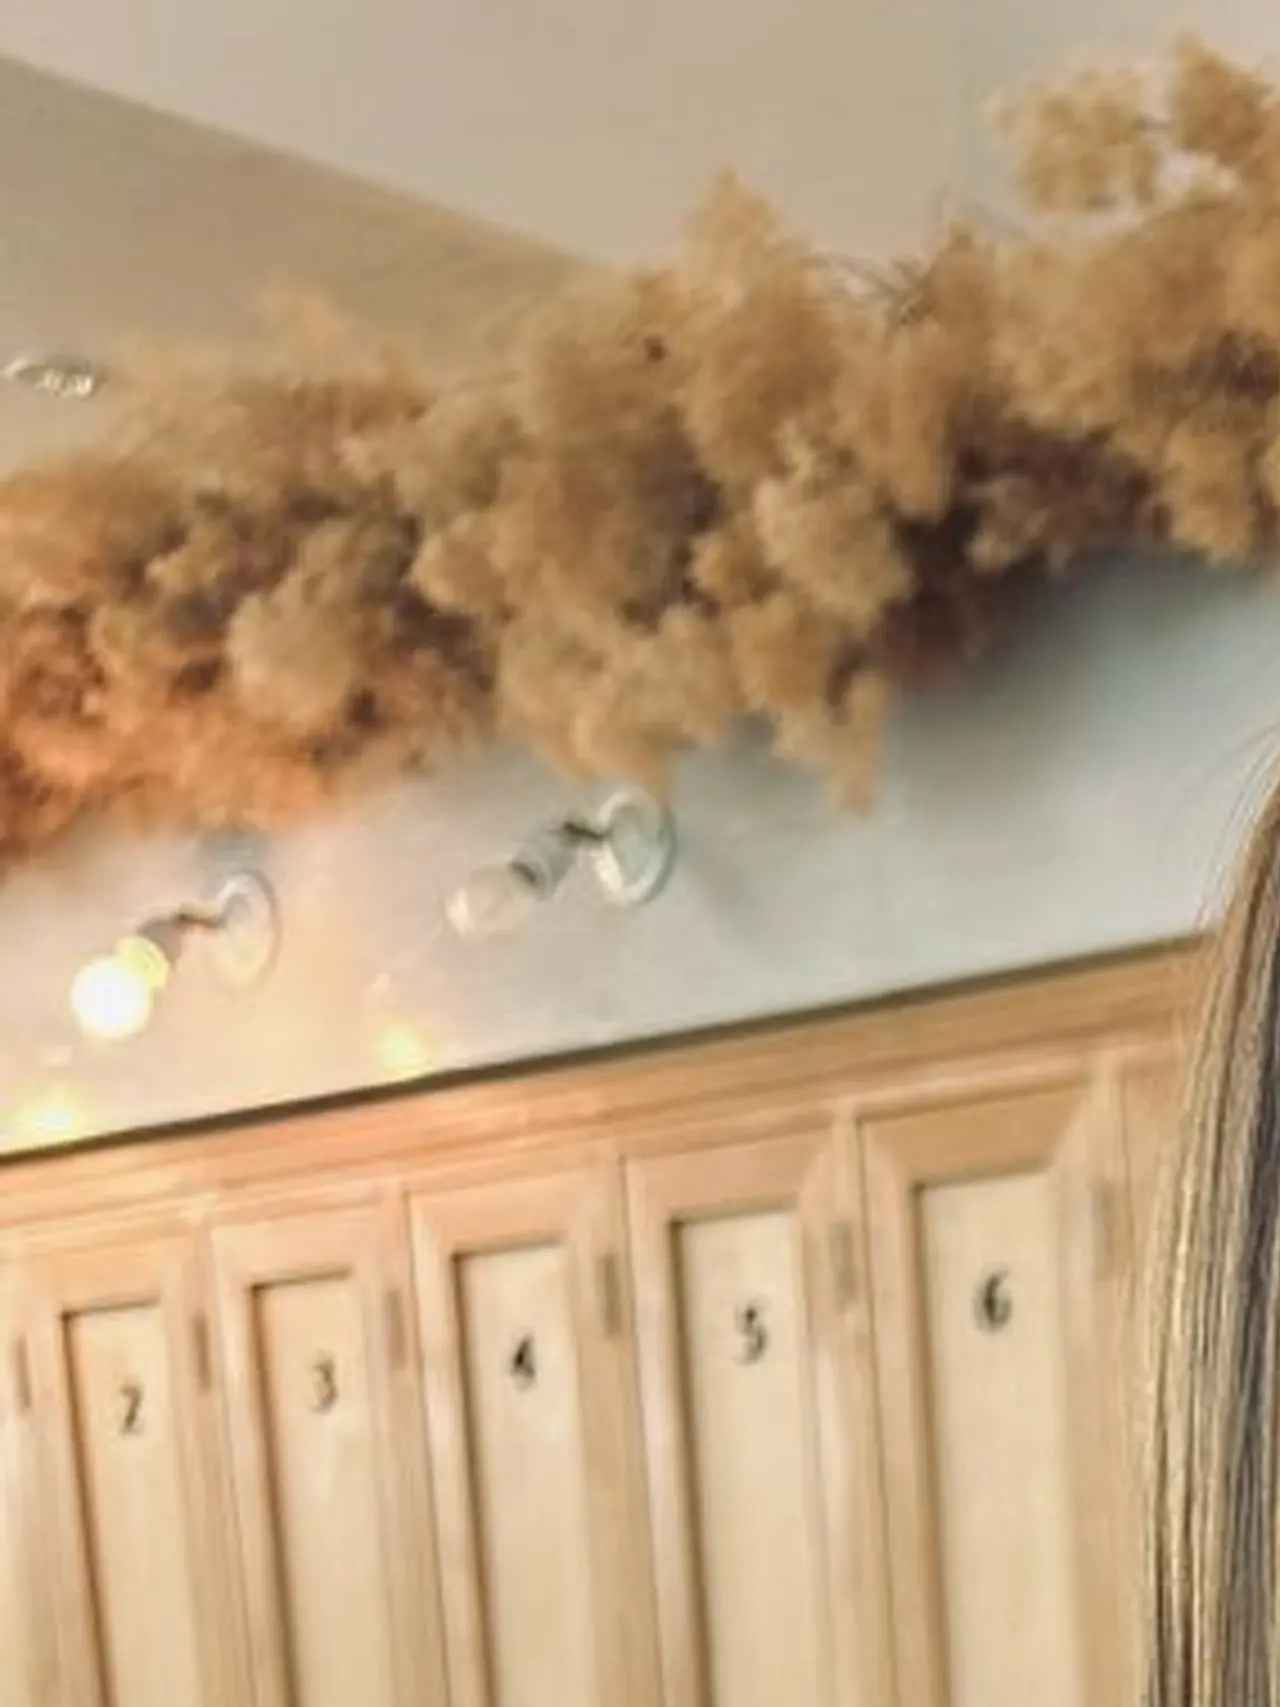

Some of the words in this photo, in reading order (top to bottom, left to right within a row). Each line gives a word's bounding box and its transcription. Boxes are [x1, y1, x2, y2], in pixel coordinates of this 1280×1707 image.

[974, 1266, 1013, 1333] 6
[511, 1332, 537, 1389] 4
[734, 1300, 767, 1366] 5
[119, 1382, 145, 1436] 2
[312, 1353, 338, 1412] 3
